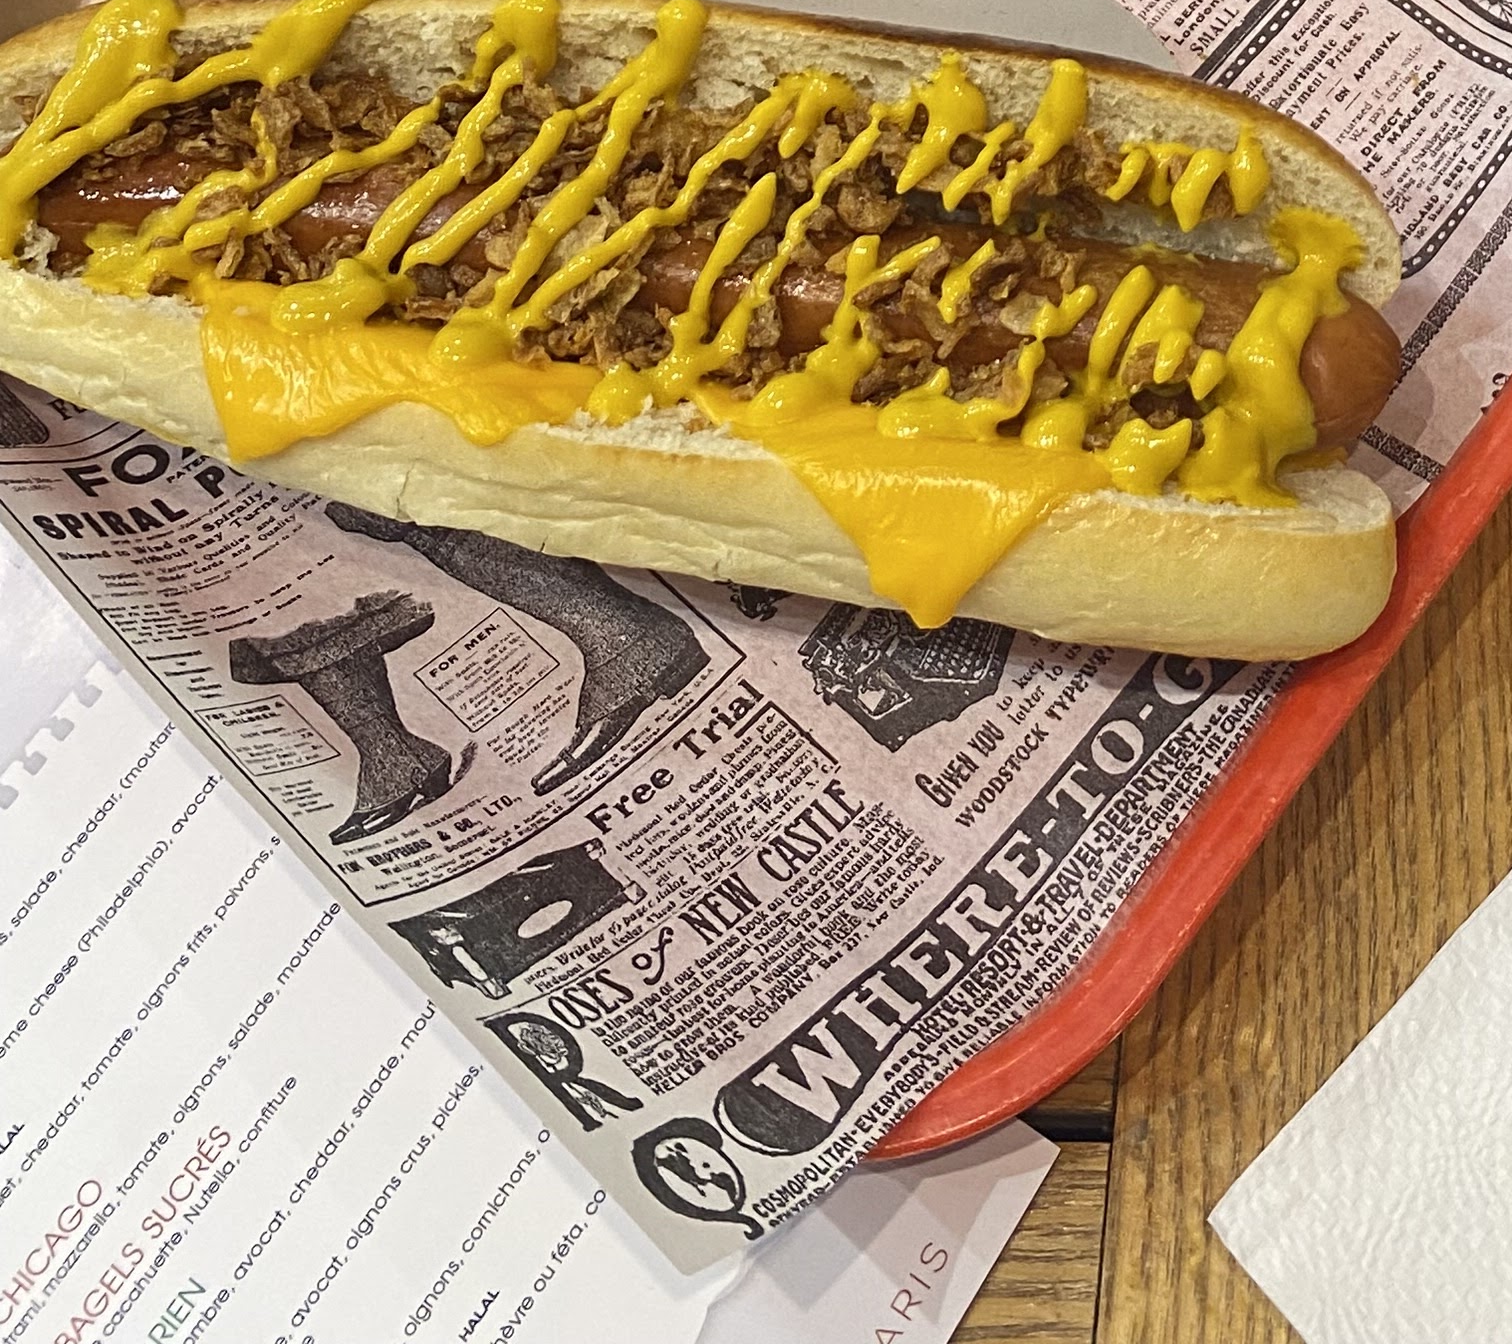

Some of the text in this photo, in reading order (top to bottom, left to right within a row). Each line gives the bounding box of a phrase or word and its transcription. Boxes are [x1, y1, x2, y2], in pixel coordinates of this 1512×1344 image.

[1188, 7, 1240, 60] SMALL
[1292, 6, 1337, 57] for Cash.
[1338, 1, 1370, 31] Easy
[1267, 45, 1290, 66] this
[1324, 31, 1365, 70] Prices.
[1359, 58, 1447, 157] DIRECT FROM
[1367, 103, 1387, 126] pay
[1386, 82, 1437, 145] MAKERS.
[33, 496, 189, 542] SPIRAL
[176, 532, 198, 544] on
[203, 492, 266, 534] Spirally
[230, 495, 281, 529] Turns
[428, 622, 500, 678] FOR MEN.
[1044, 661, 1064, 682] to
[966, 719, 1005, 758] YOU
[1012, 655, 1045, 689] keep
[584, 679, 771, 835] Free Trial
[955, 722, 1049, 827] WOODSTOCK
[435, 829, 451, 842] &
[1105, 798, 1153, 853] THESE
[10, 868, 63, 928] salade,
[60, 792, 122, 864] cheddar,
[630, 925, 674, 986] of
[678, 871, 761, 945] NEW
[747, 779, 872, 881] CASTLE
[28, 774, 223, 1016] cheese (Philadelphia), avocat,
[734, 875, 810, 937] book rose
[1075, 898, 1096, 922] OF
[20, 849, 274, 1172] cheddar, tomate, oignons frits, poivrons,
[42, 902, 341, 1296] mozzarella, tomate, oignons, salade, moutarde
[233, 1053, 404, 1280] avocat, cheddar, salade,
[290, 1064, 484, 1327] avocat, oignons crus, pickles,
[55, 1125, 231, 1344] BAGELS SUCRÉS
[102, 1076, 297, 1336] cacahuette, Nutella, confiture
[403, 1149, 540, 1336] oignons, cornichons,
[532, 1222, 588, 1293] ou féta,
[458, 1290, 500, 1342] HALAL
